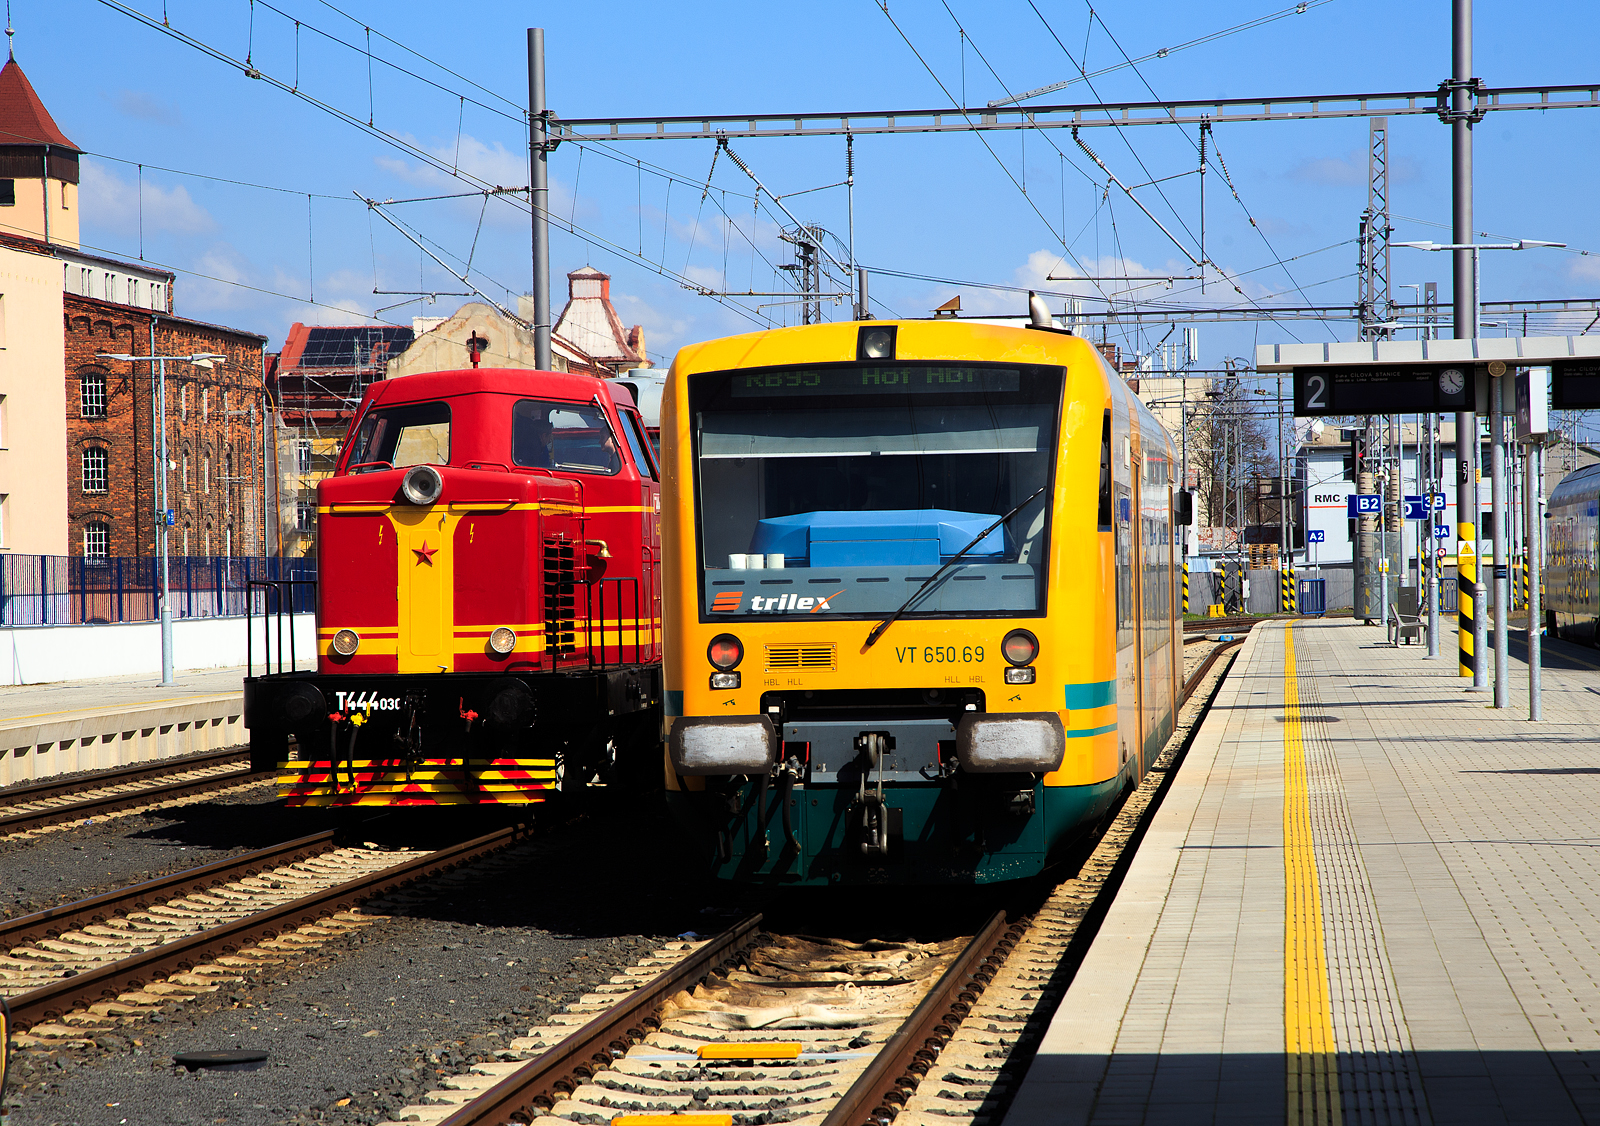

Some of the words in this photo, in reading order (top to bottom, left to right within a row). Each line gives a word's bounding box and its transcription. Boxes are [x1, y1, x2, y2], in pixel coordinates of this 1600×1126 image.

[862, 367, 909, 385] Hof
[1307, 375, 1326, 408] 2
[1314, 494, 1341, 503] RMC
[1359, 498, 1379, 510] B2
[1424, 496, 1444, 508] 3B
[1309, 532, 1324, 541] A2
[1434, 528, 1449, 536] 3A
[750, 588, 847, 613] trilex
[895, 646, 917, 664] VT
[923, 645, 985, 663] 650.69
[787, 678, 803, 686] HLL
[944, 675, 961, 684] HLL
[968, 675, 985, 684] HBL
